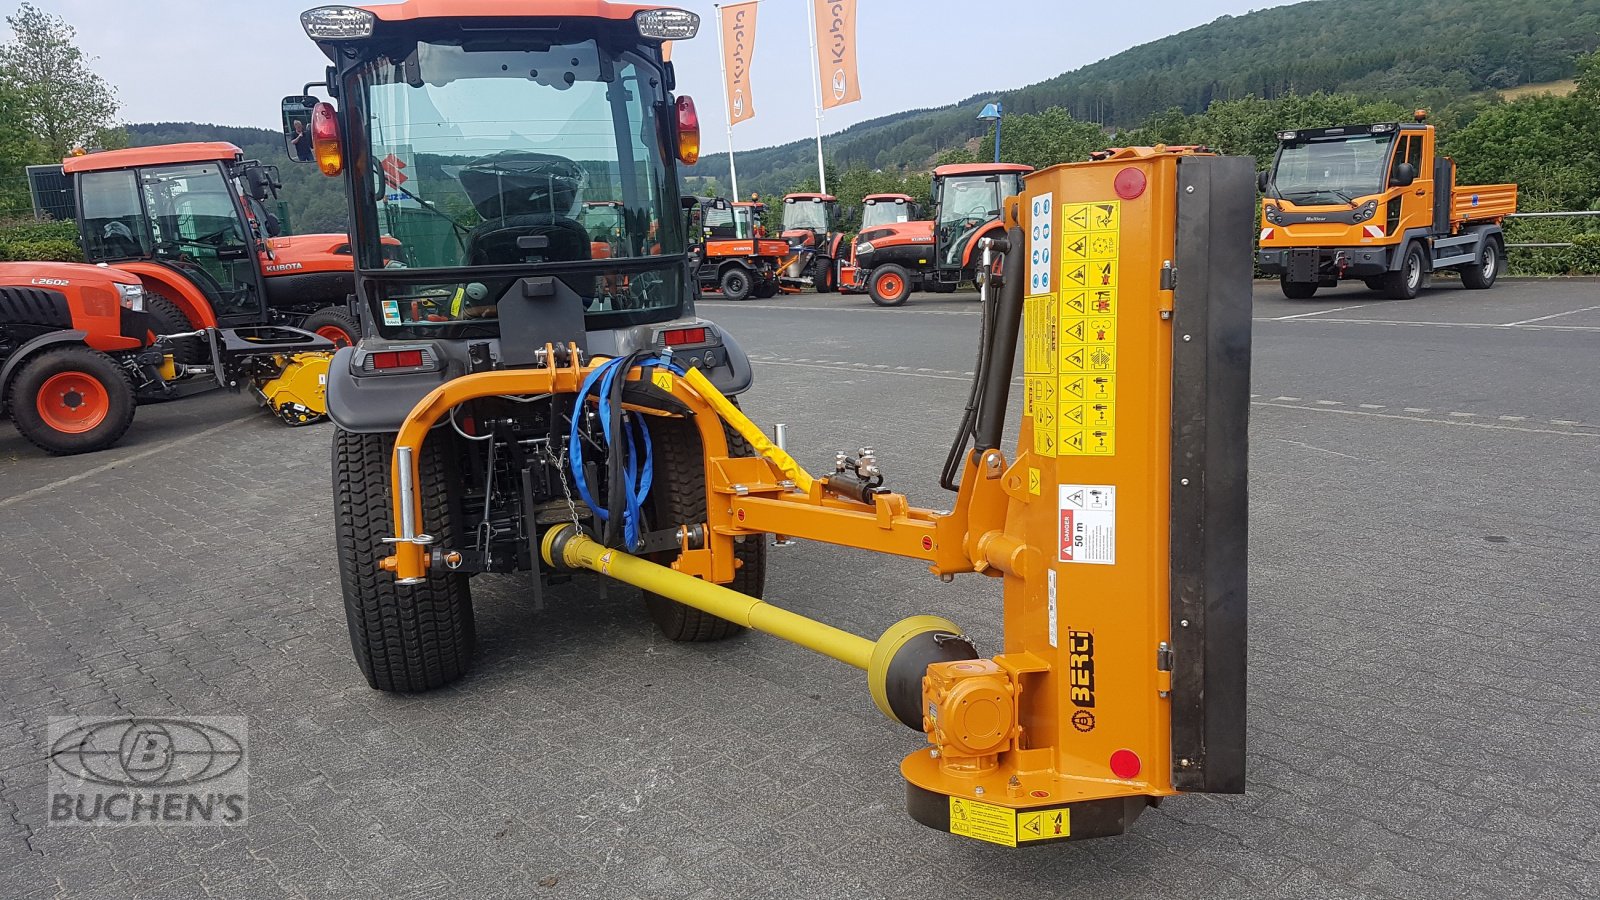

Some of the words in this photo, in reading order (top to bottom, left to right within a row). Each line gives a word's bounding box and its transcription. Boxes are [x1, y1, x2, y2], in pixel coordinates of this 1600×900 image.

[733, 10, 746, 84] Kubota
[266, 262, 303, 272] KUBOTA
[31, 278, 70, 286] L2602
[1075, 522, 1083, 532] m
[1074, 535, 1083, 547] 50
